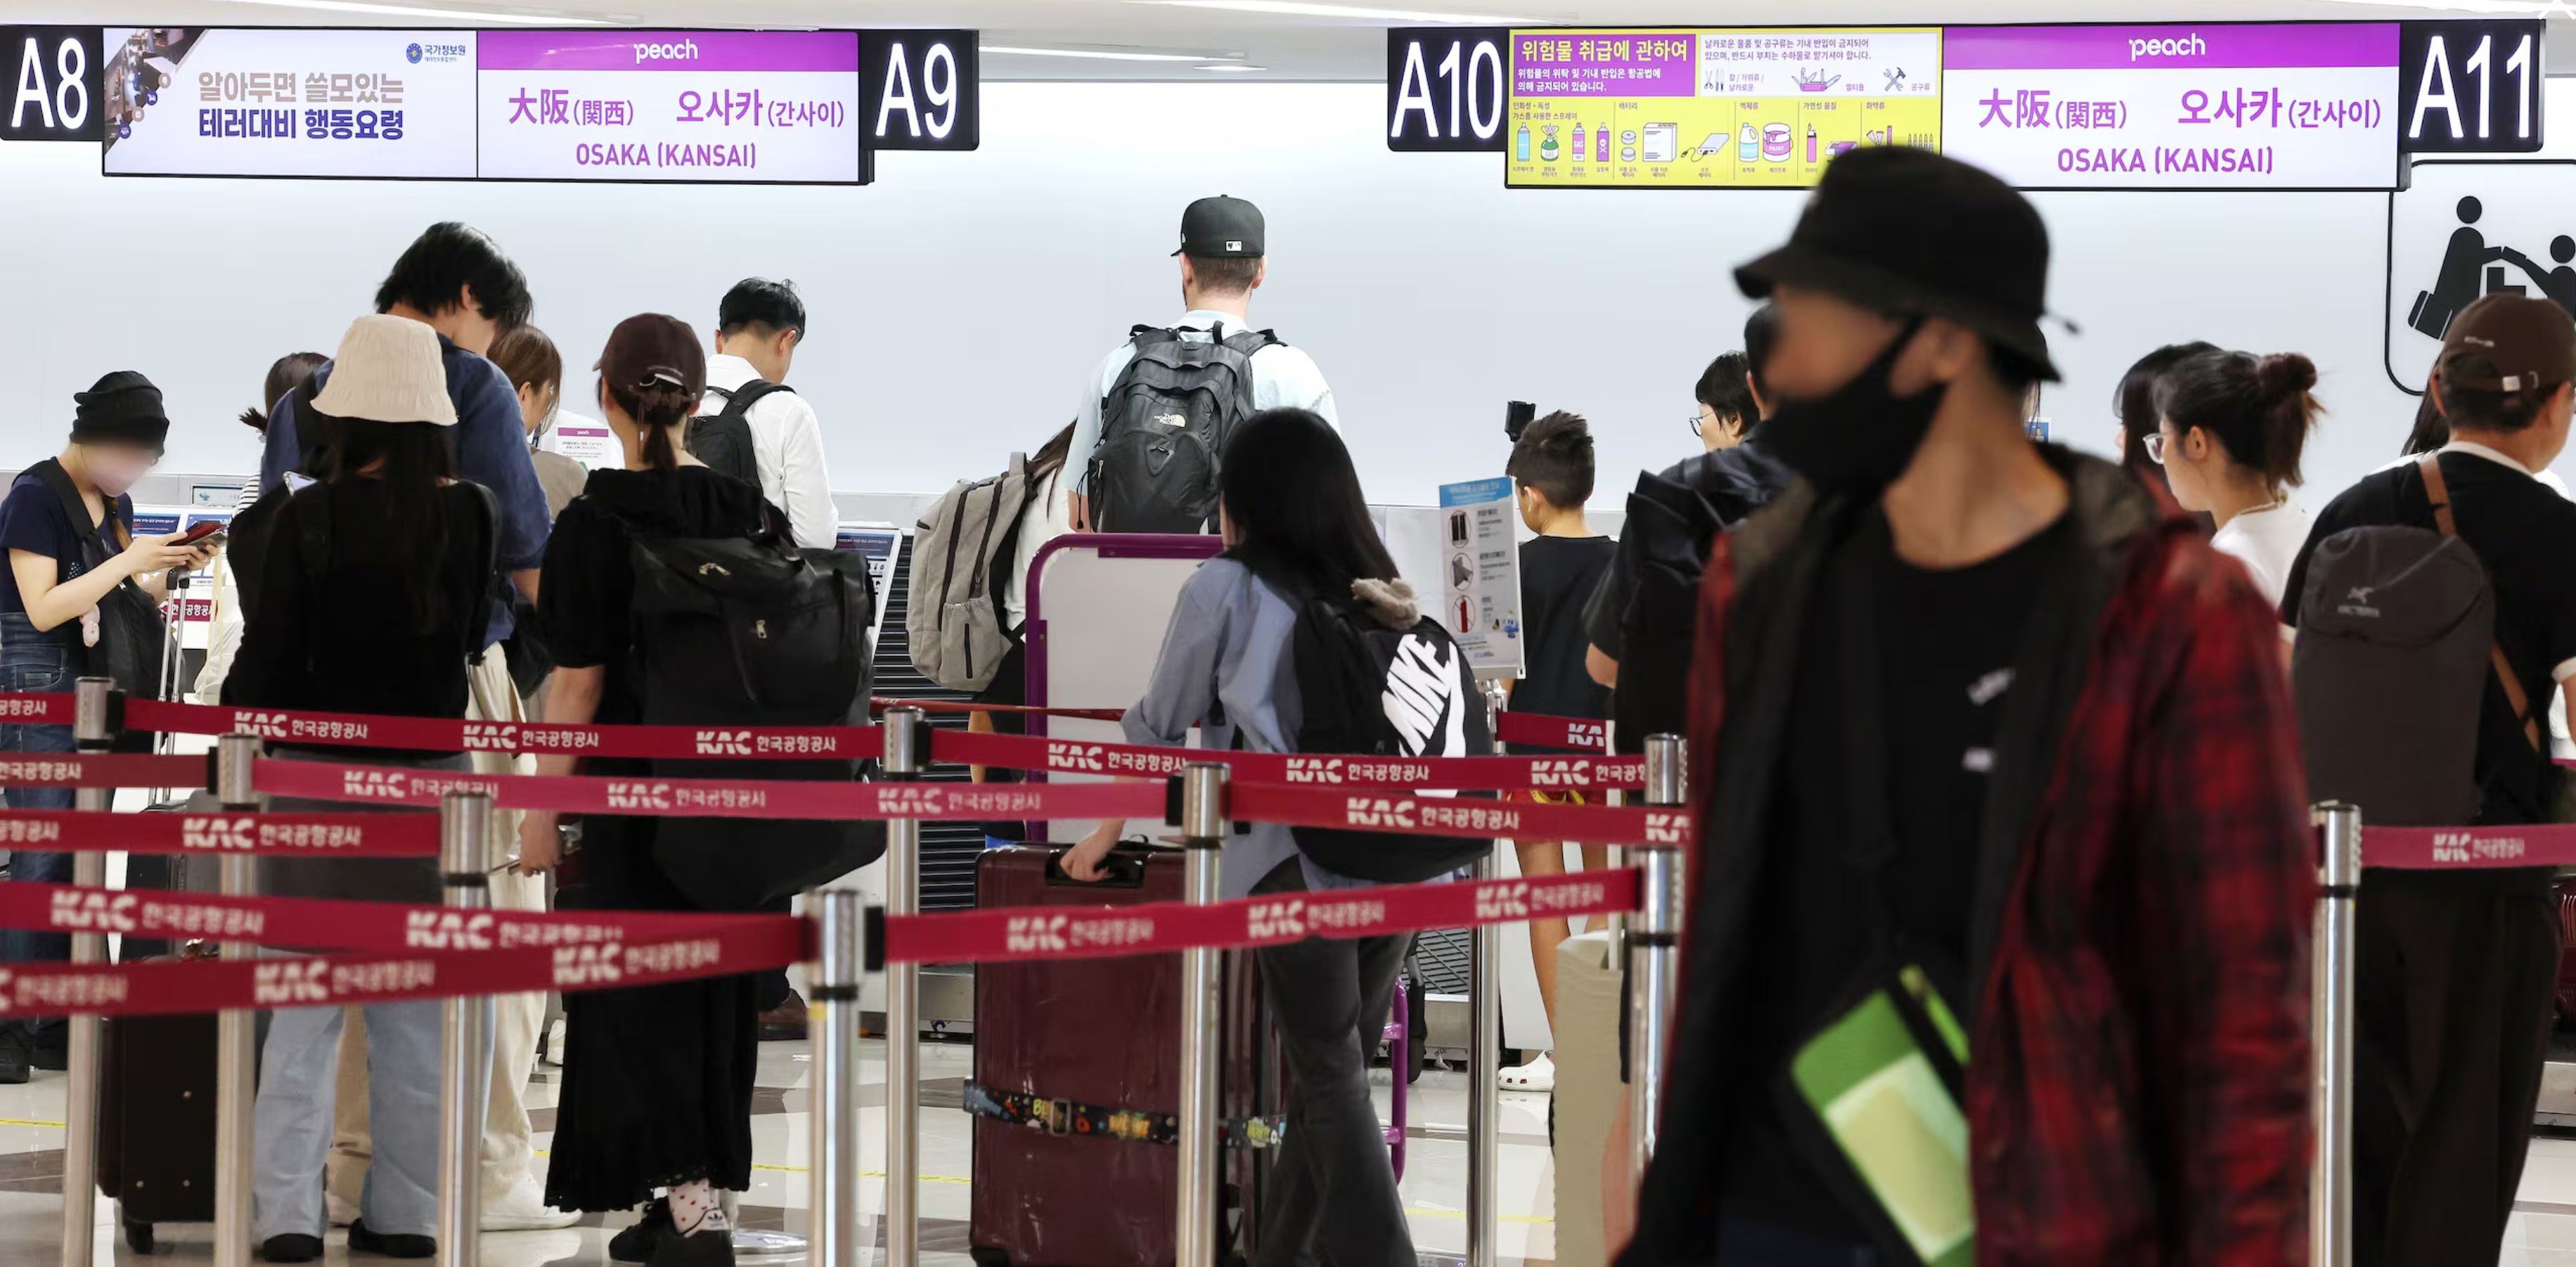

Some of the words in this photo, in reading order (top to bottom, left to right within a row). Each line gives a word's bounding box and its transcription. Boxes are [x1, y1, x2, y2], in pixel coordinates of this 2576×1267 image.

[425, 45, 465, 56] 국가정보원
[633, 39, 697, 64] peach
[1522, 41, 1572, 61] 위험물
[1579, 40, 1629, 61] 취급에
[1636, 40, 1687, 61] 관하여
[1705, 39, 1734, 49] 날카로운
[1755, 39, 1761, 48] 및
[1764, 39, 1793, 49] 공구류는
[1796, 39, 1811, 48] 기내
[1814, 39, 1836, 48] 반입이
[1839, 39, 1868, 48] 금지되어
[1705, 51, 1730, 60] 있으며,
[1732, 51, 1753, 60] 반드시
[1757, 51, 1778, 60] 부치는
[1782, 51, 1810, 60] 수하물로
[1846, 51, 1871, 60] 합니다.
[2128, 35, 2205, 61] peach
[11, 38, 89, 129] A8
[199, 72, 296, 103] 알아두면
[305, 72, 404, 103] 쓸모있는
[1518, 82, 1533, 91] 의해
[1537, 82, 1569, 91] 금지되어
[1571, 82, 1606, 91] 있습니다.
[1519, 68, 1550, 79] 위험물의
[1553, 69, 1569, 79] 위탁
[1572, 68, 1579, 78] 및
[1583, 68, 1598, 79] 기내
[1601, 68, 1625, 79] 반입은
[1628, 68, 1660, 79] 항공법에
[2409, 34, 2531, 138] A11
[875, 43, 956, 139] A9
[1391, 41, 1502, 139] A10
[509, 87, 633, 125] 大阪(関西)
[677, 89, 844, 127] 오사카(간사이)
[1979, 88, 2126, 129] 大阪(関西)
[2178, 87, 2381, 128] 오사카(간사이)
[200, 109, 296, 139] 테러대비
[305, 109, 403, 140] 행동요령
[577, 143, 650, 165] OSAKA
[658, 142, 755, 169] (KANSAI)
[2059, 148, 2146, 172] OSAKA
[2156, 146, 2272, 174] (KANSAI)
[1381, 633, 1451, 757] NIKE
[235, 712, 287, 737] KAC
[292, 719, 368, 739] 한국공항공사
[463, 725, 517, 749] KAC
[522, 731, 598, 747] 한국공항공사
[1568, 723, 1604, 747] KA
[697, 731, 751, 754] KAC
[757, 735, 836, 752] 한국공항공사
[1048, 744, 1102, 771] KAC
[1108, 752, 1186, 771] 한국공항공사
[1287, 759, 1342, 783] KAC
[1348, 764, 1429, 782] 한국공항공사
[344, 771, 404, 798] KAC
[1531, 760, 1589, 785] KAC
[608, 783, 669, 809] KAC
[676, 789, 765, 807] 한국공항공사
[879, 788, 941, 813] KAC
[948, 793, 1041, 811] 한국공항공사
[1348, 798, 1415, 828] KAC
[1422, 806, 1519, 830] 한국공항공사
[183, 818, 253, 848] KAC
[259, 824, 361, 847] 한국공항공사
[2433, 834, 2471, 862] KAC
[51, 890, 137, 930] KAC
[1476, 883, 1528, 918] KAC
[407, 911, 494, 949] KAC
[1007, 915, 1066, 951] KAC
[1249, 901, 1303, 938] KAC
[553, 943, 622, 984] KAC
[255, 960, 328, 1003] KAC
